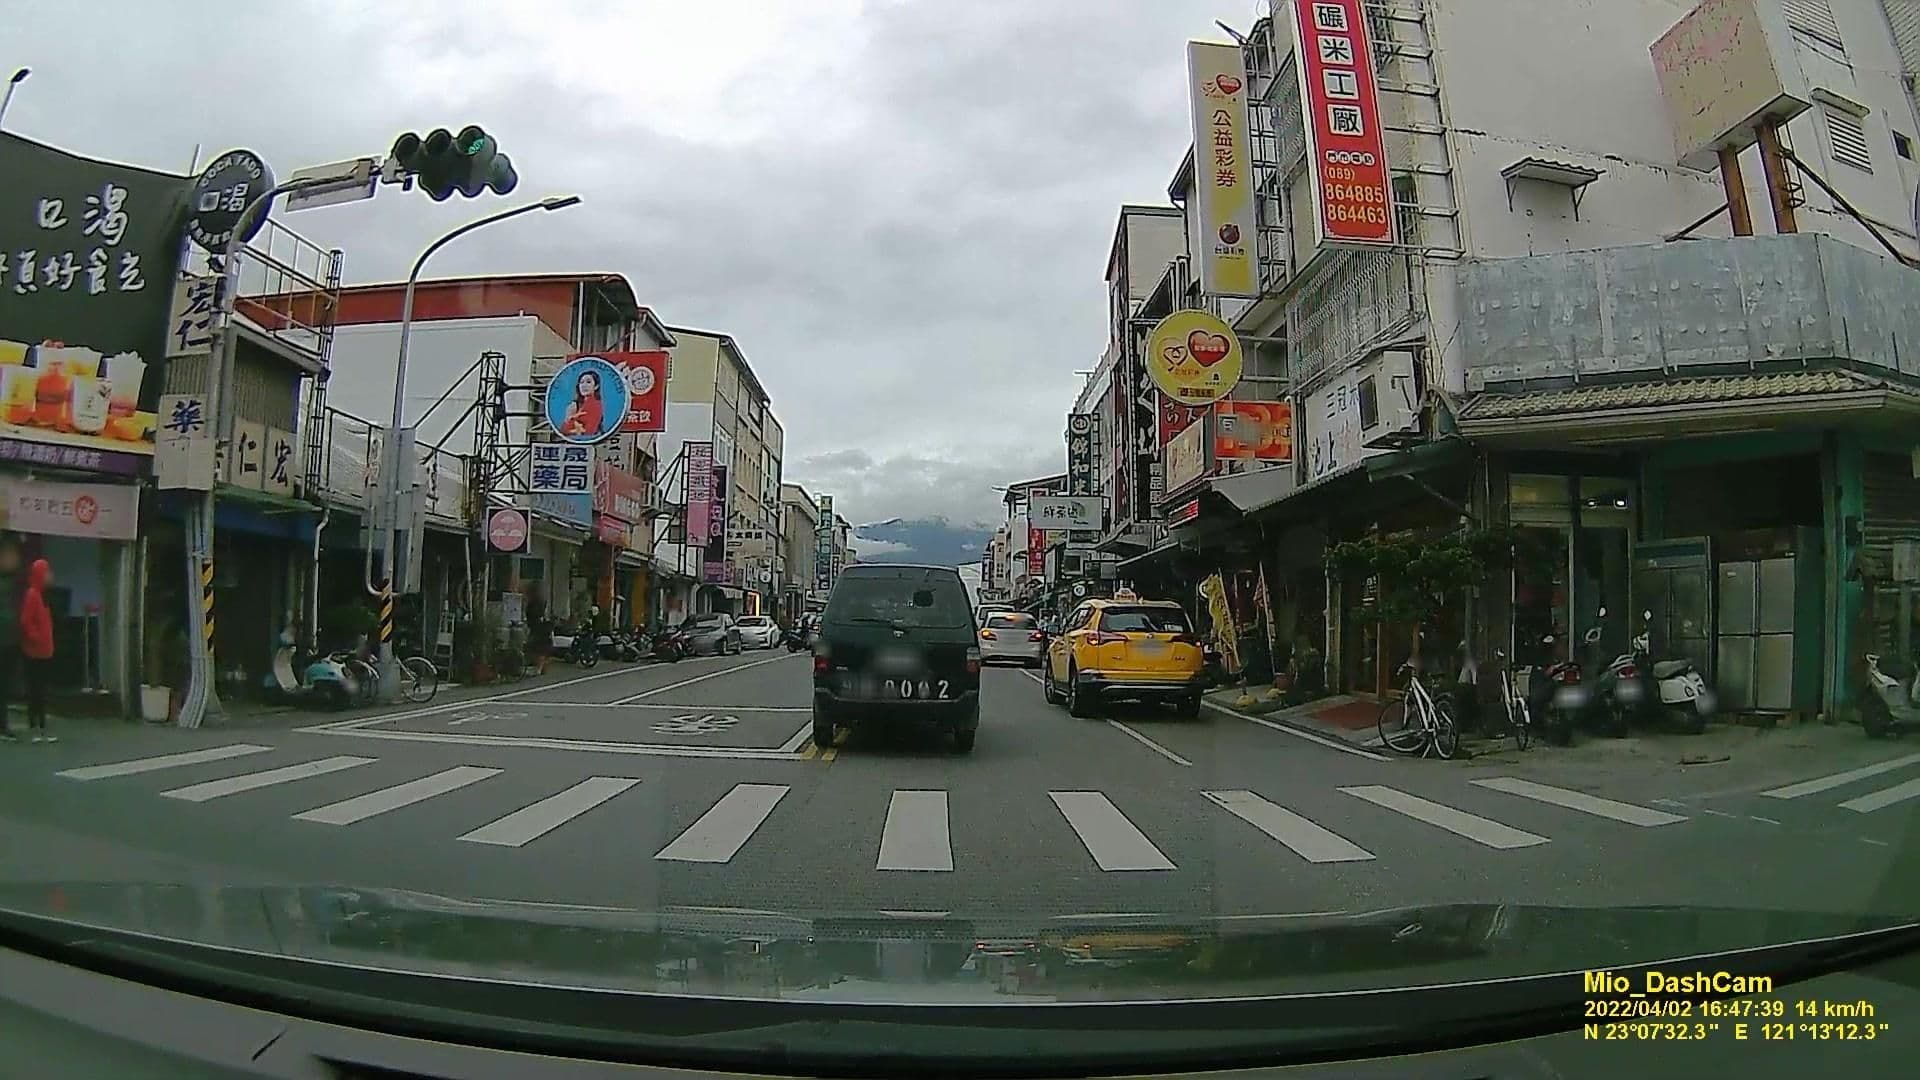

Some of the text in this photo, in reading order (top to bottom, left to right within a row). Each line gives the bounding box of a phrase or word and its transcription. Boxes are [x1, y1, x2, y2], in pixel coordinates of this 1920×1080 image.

[1317, 5, 1360, 133] 碾米工廠
[1212, 109, 1237, 188] 公益彩券
[1325, 167, 1355, 182] (089)
[199, 183, 249, 211] 口渴
[1325, 184, 1383, 204] 864885
[40, 183, 128, 245] 口渴
[1327, 205, 1386, 225] 864463
[533, 465, 588, 490] 藥局
